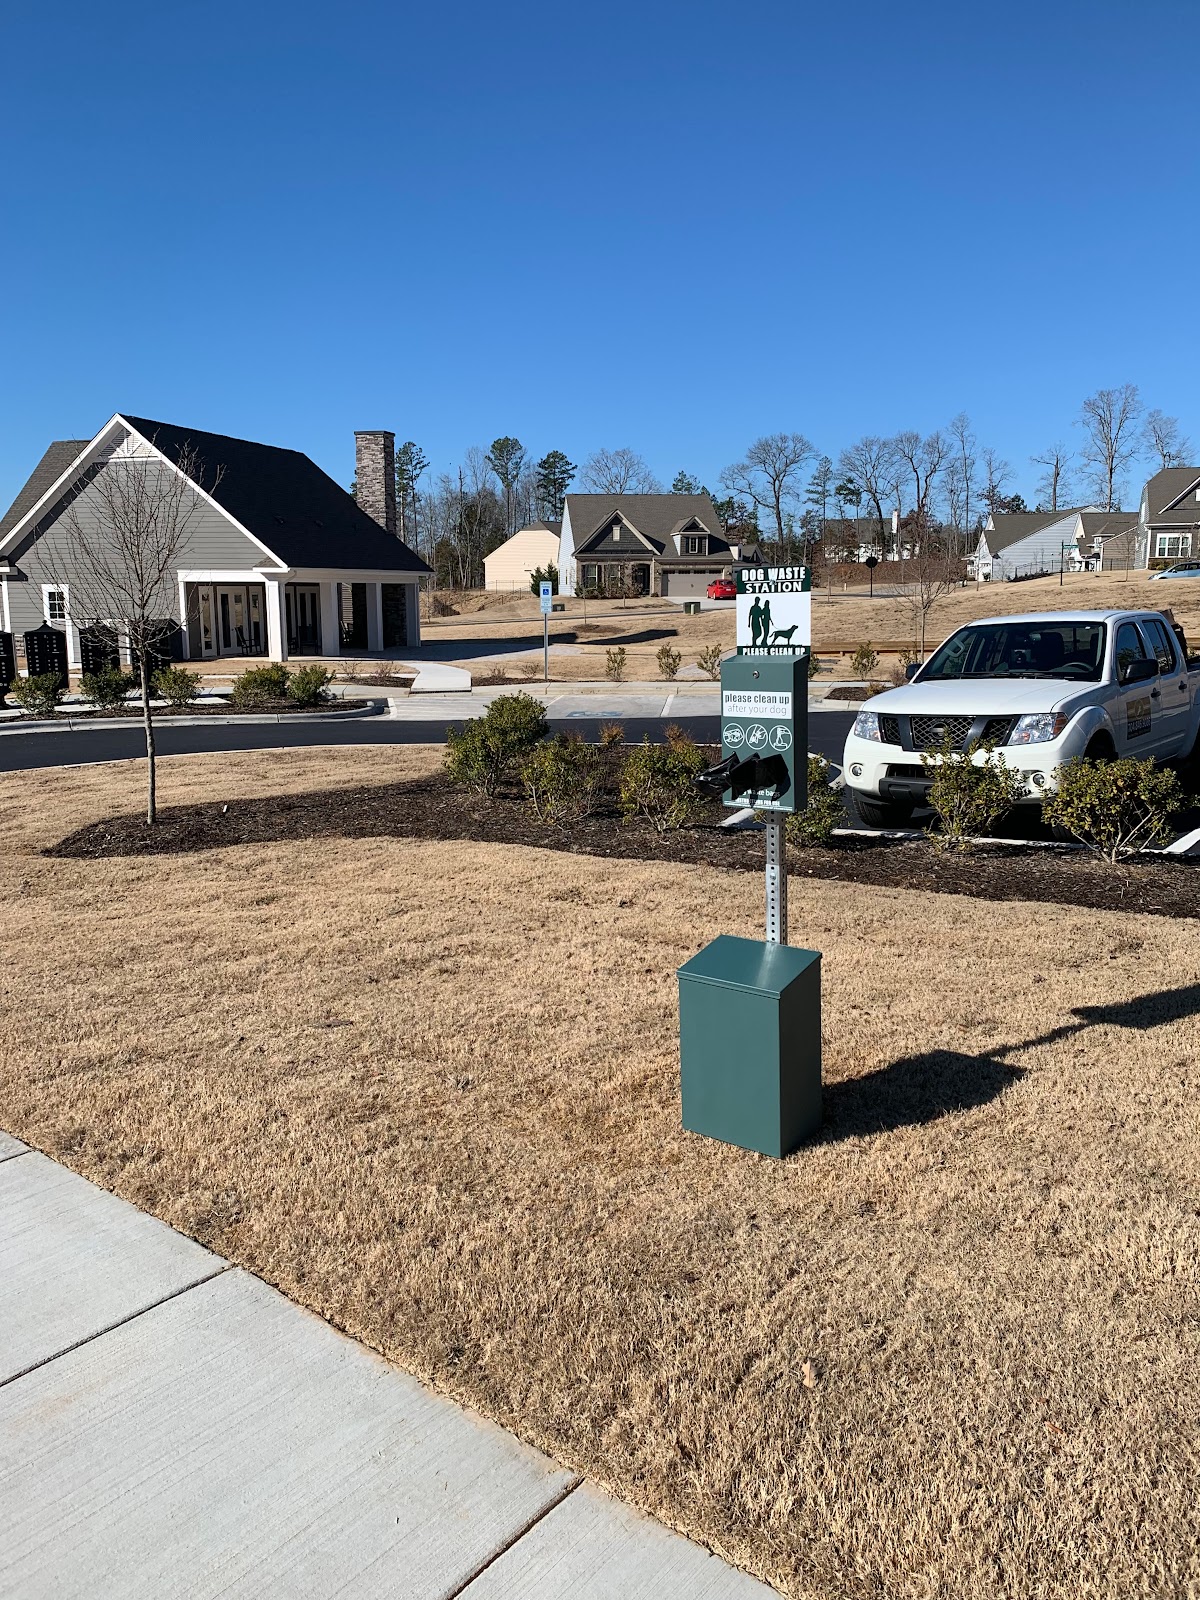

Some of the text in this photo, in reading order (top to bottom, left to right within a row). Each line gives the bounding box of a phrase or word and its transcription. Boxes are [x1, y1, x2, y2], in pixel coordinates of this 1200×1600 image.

[741, 566, 806, 581] DOG WASTE
[745, 581, 802, 594] STATION
[742, 647, 806, 656] PLEASE CLEAN UP
[724, 693, 790, 705] please clean up
[727, 703, 787, 716] after your dog
